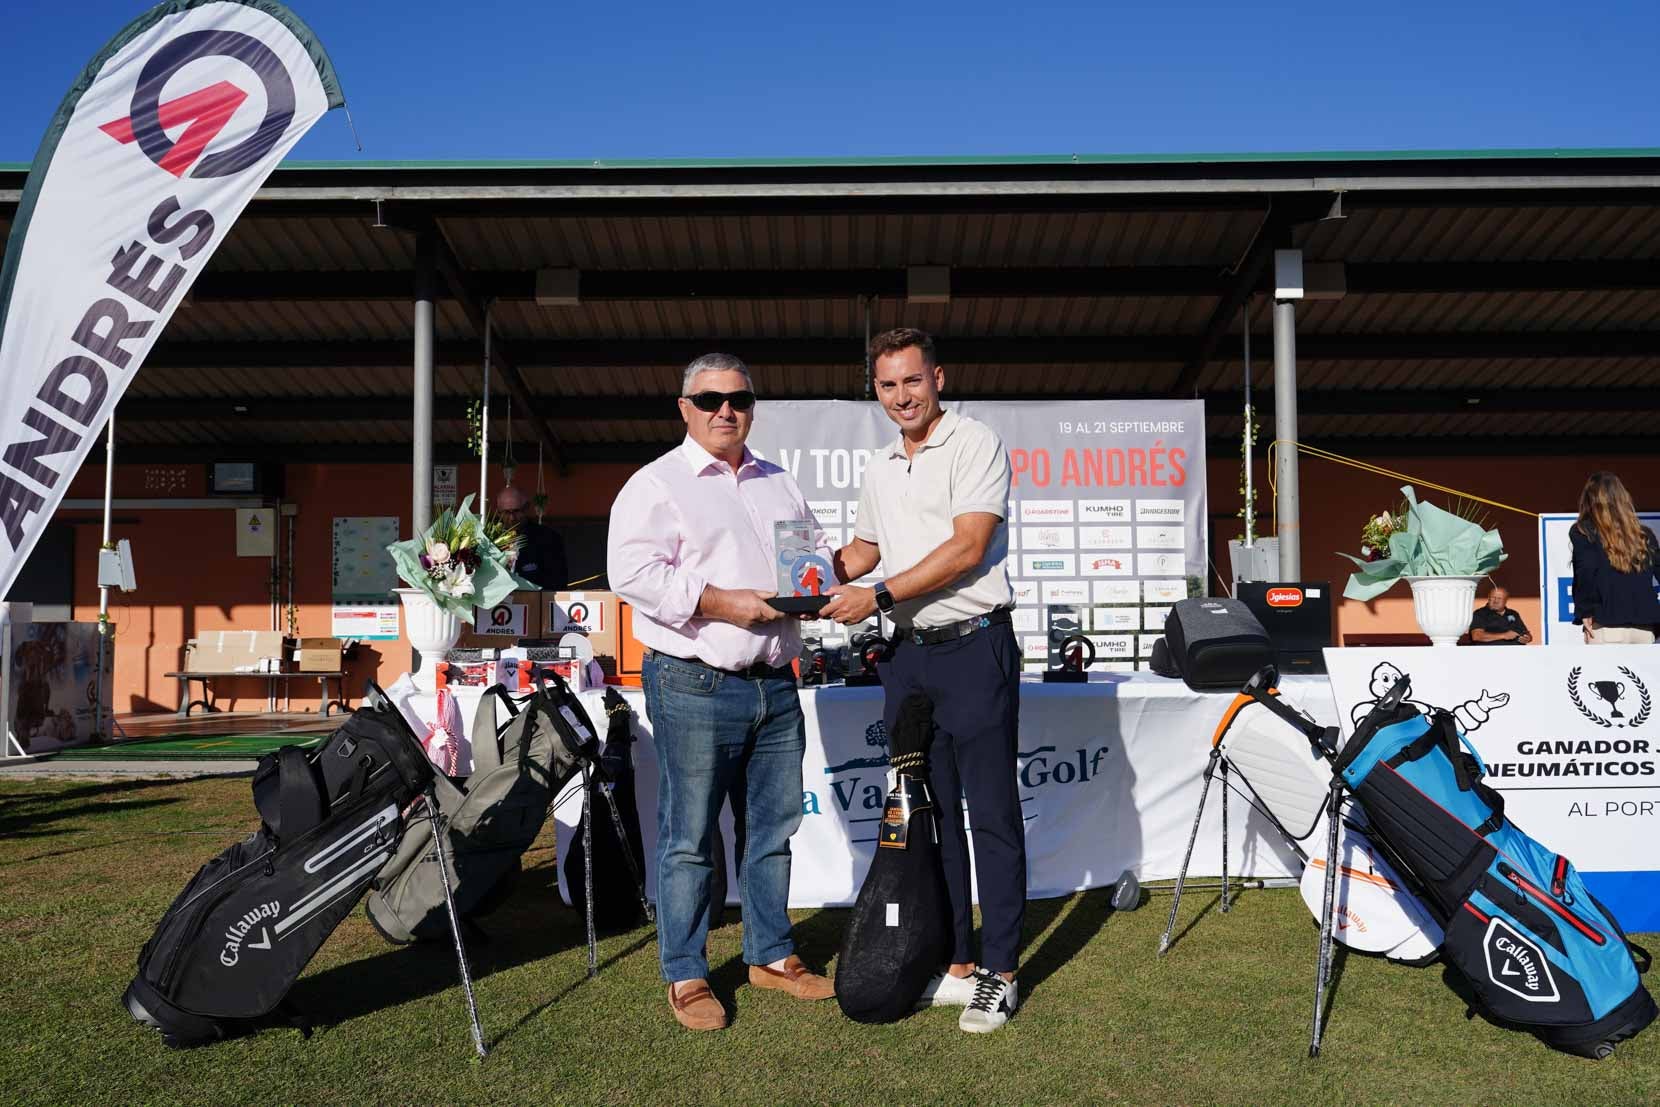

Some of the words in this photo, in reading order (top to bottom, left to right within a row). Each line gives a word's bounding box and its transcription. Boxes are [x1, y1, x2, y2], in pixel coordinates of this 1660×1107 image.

[0, 195, 216, 553] ANDRÉS
[1059, 421, 1072, 433] 19
[1076, 422, 1091, 433] AL
[1094, 422, 1106, 433] 21
[1110, 421, 1185, 433] SEPTIEMBRE
[1061, 439, 1187, 487] ANDRÉS
[1517, 740, 1650, 755] GANADOR
[1020, 746, 1109, 788] Golf
[1484, 758, 1655, 778] NEUMÁTICOS
[1567, 801, 1598, 817] AL
[1605, 800, 1660, 816] POR
[220, 900, 281, 967] Callaway
[1331, 904, 1367, 933] allaway
[1495, 937, 1540, 991] Callaway
